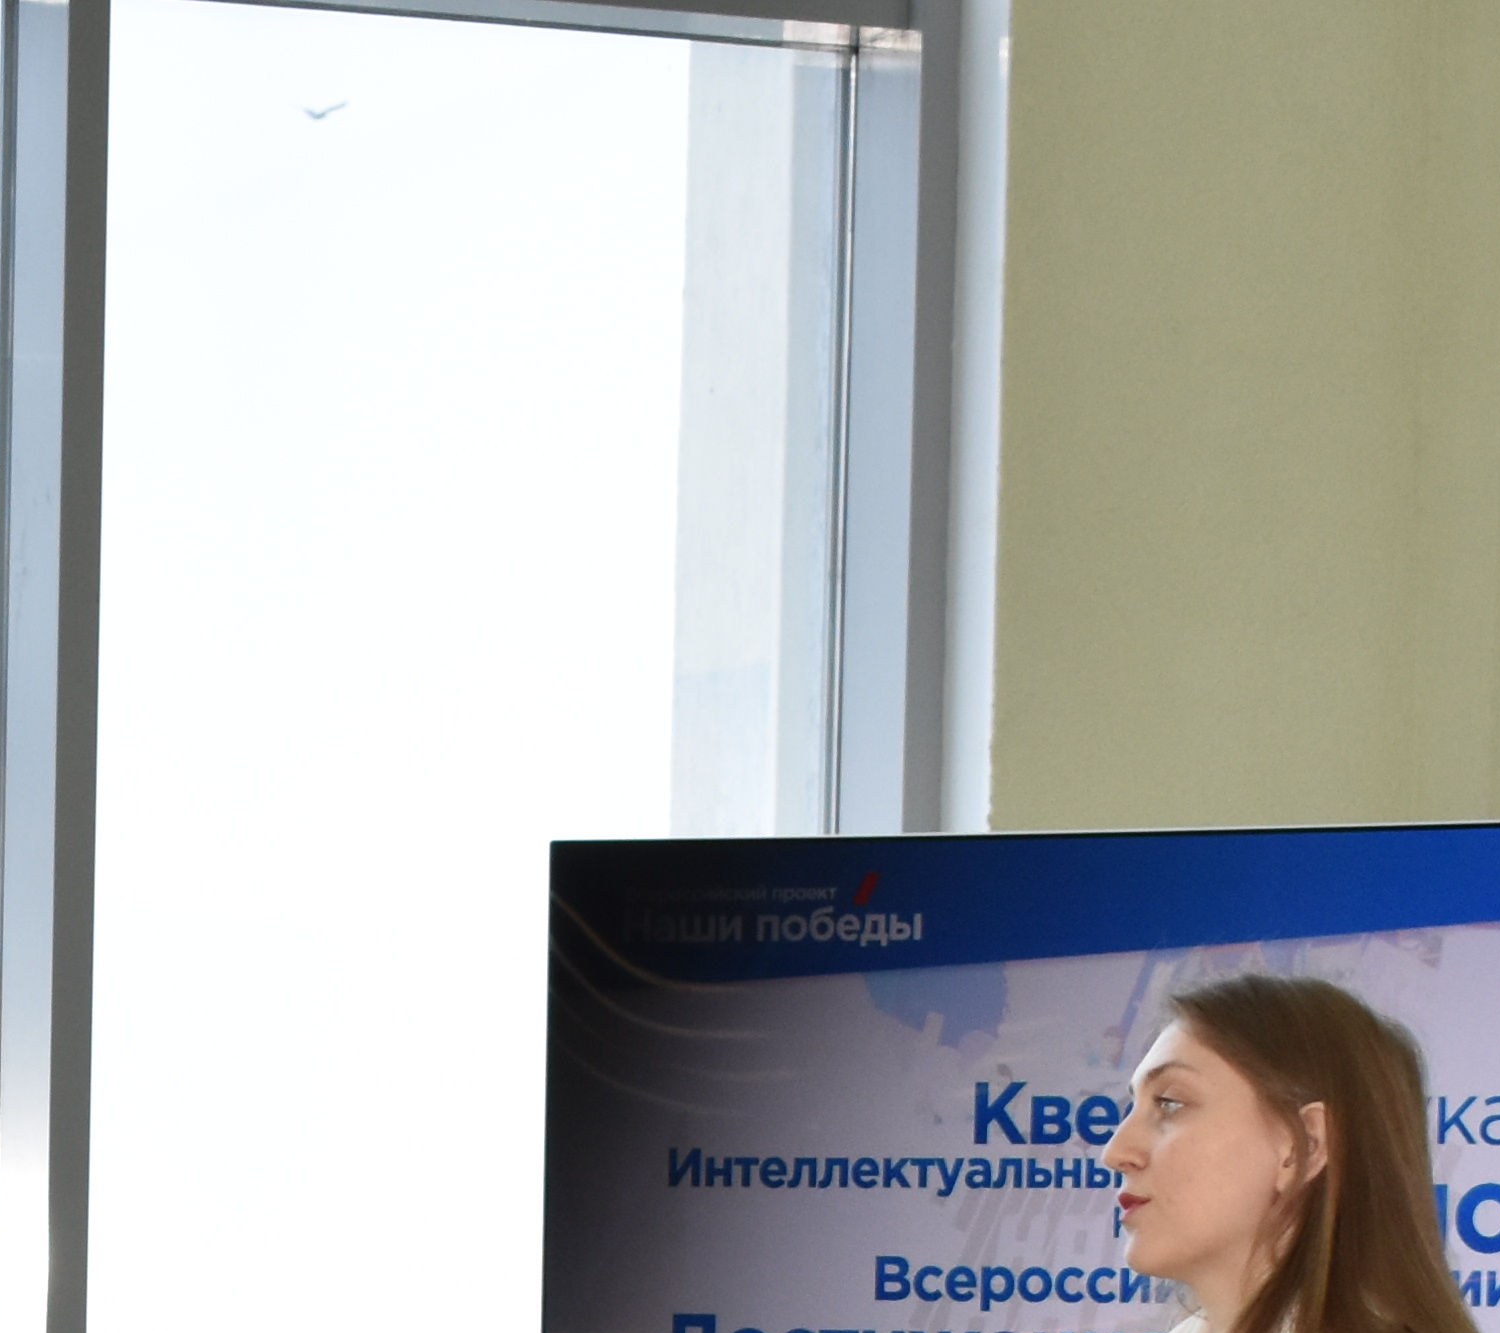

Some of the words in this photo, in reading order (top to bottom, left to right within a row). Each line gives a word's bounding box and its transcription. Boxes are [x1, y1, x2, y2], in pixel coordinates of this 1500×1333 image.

[624, 883, 768, 903] российский
[771, 886, 838, 904] проект
[622, 906, 744, 943] Наши
[756, 905, 924, 947] победы
[973, 1081, 1135, 1146] Кве
